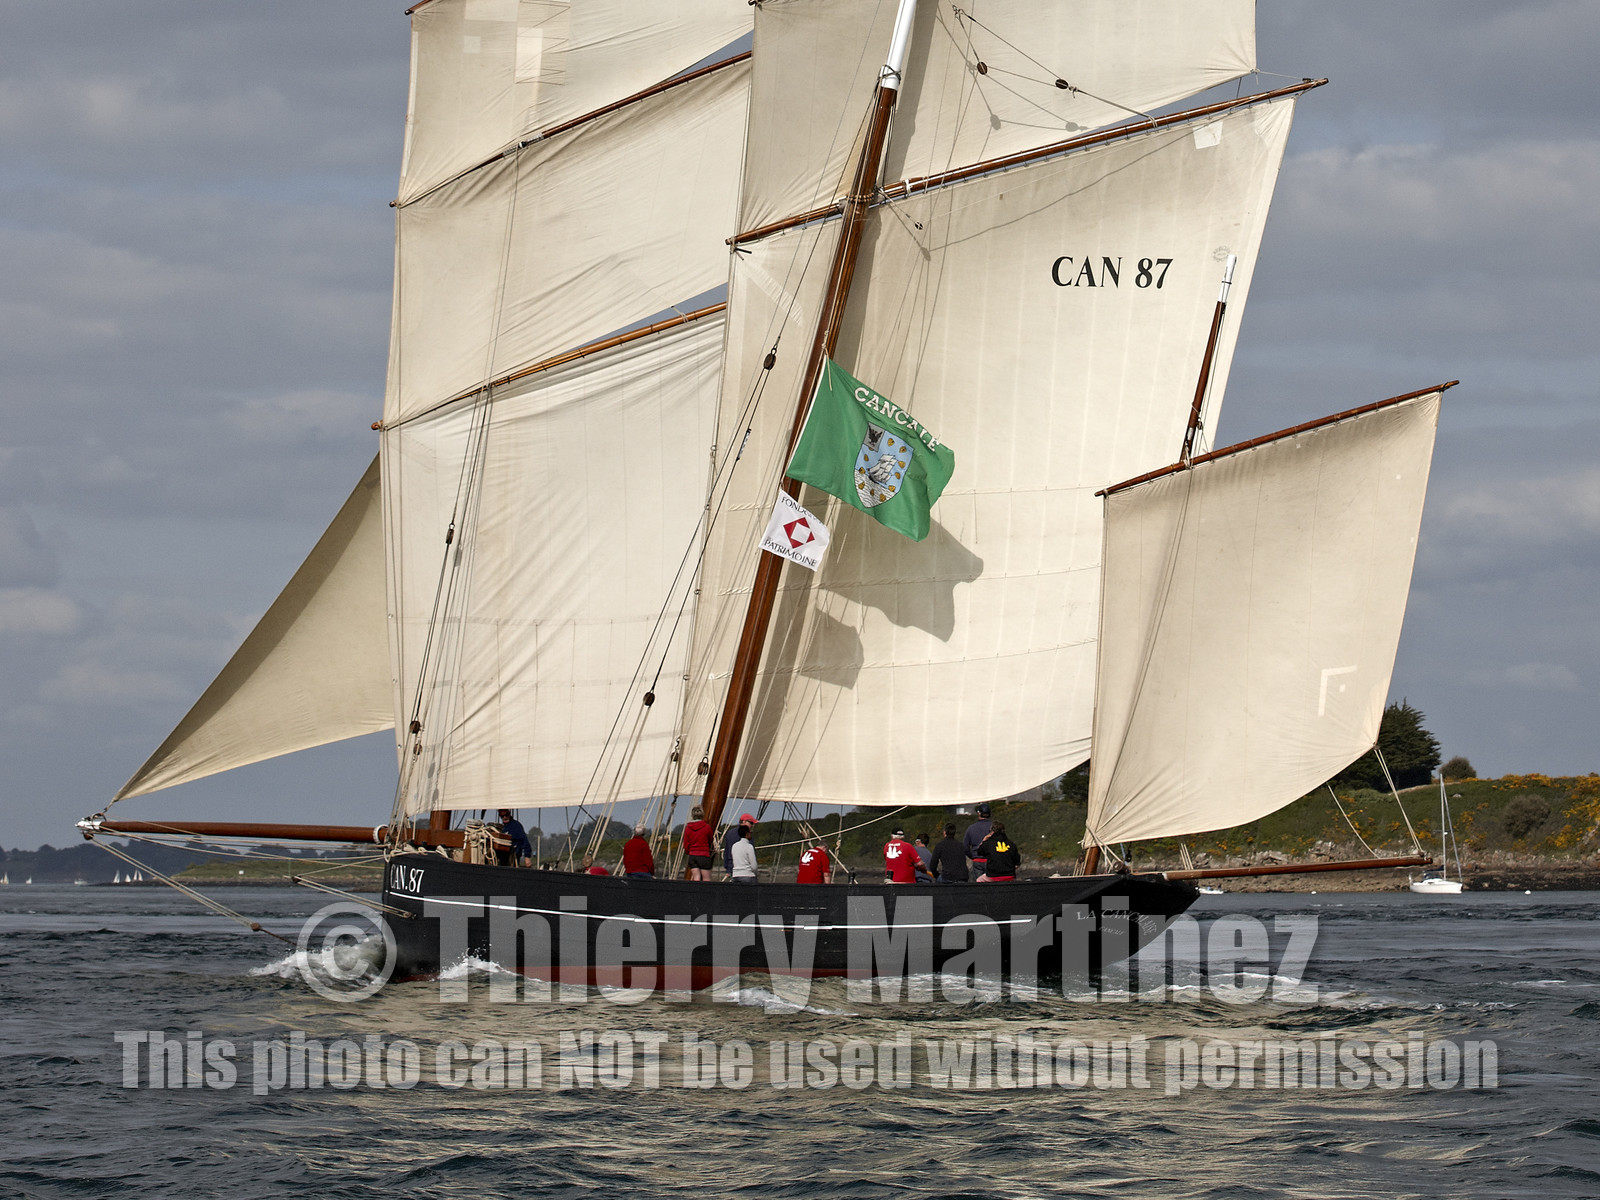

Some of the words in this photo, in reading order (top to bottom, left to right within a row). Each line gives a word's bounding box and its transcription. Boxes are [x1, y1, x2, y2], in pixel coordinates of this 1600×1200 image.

[1051, 255, 1123, 289] CAN
[1135, 257, 1174, 289] 87
[854, 386, 940, 452] CANCALE
[764, 538, 817, 567] PATRIMOINE
[390, 863, 425, 893] CAN.87
[1076, 909, 1096, 920] LA
